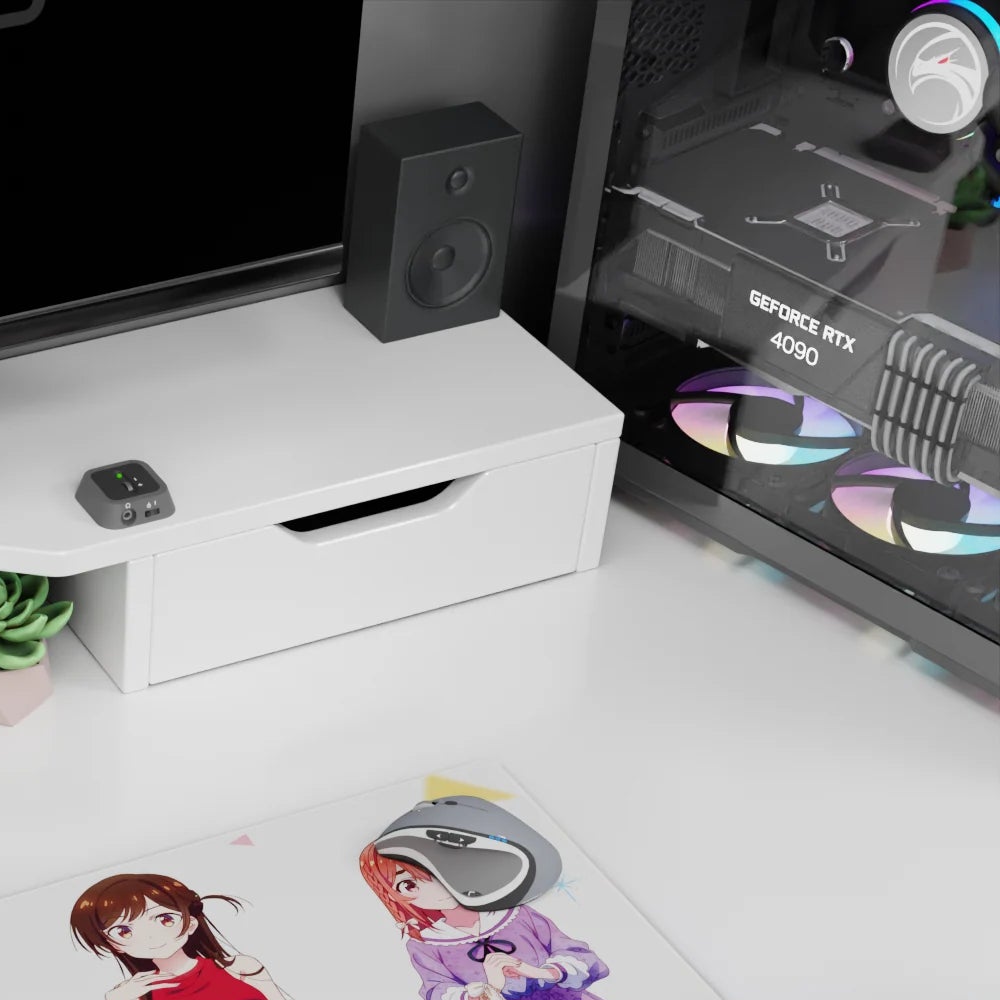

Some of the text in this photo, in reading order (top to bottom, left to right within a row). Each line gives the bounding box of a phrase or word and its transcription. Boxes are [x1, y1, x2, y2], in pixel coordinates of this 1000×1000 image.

[749, 289, 857, 354] GEFORCE RTX
[769, 331, 819, 367] 4090
